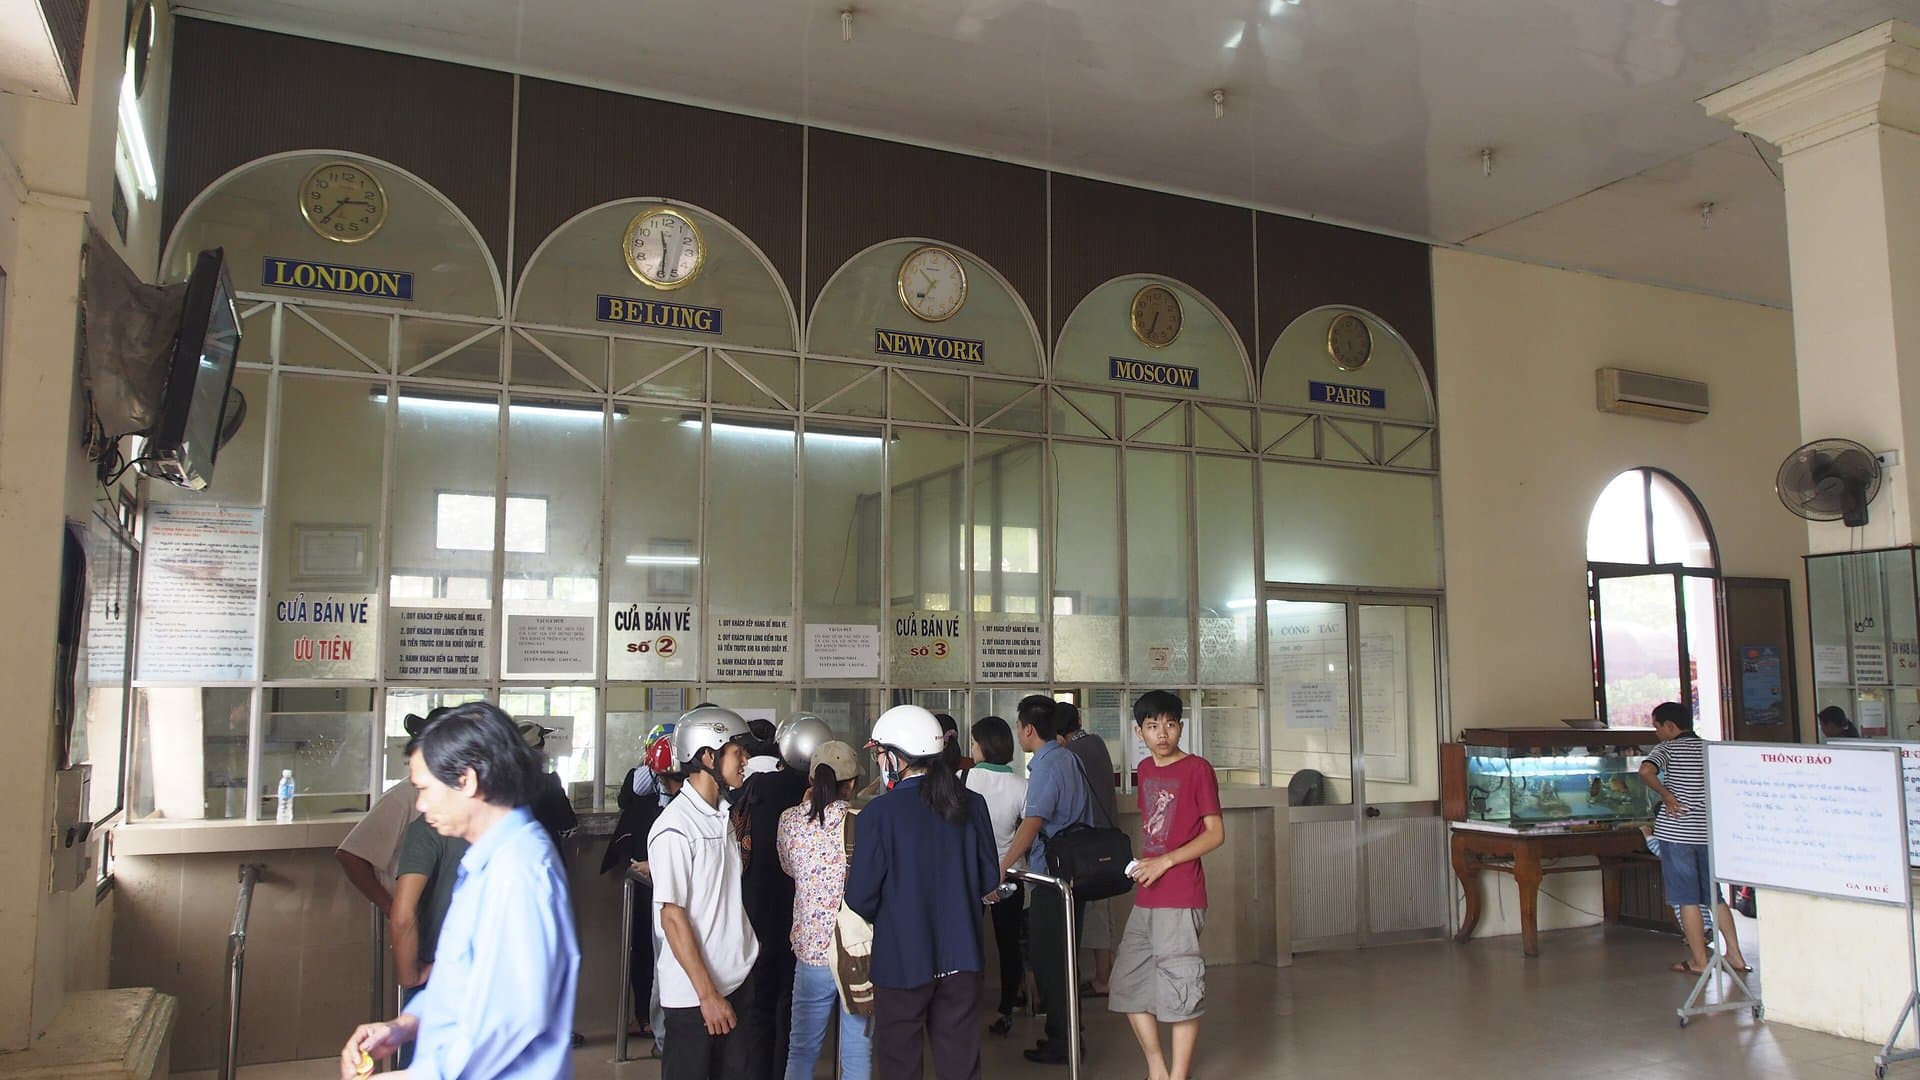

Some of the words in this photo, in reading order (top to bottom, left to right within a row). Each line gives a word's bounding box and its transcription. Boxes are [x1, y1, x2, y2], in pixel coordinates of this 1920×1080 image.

[651, 220, 658, 228] 11
[662, 218, 675, 228] 12
[640, 227, 650, 236] 10
[634, 239, 644, 247] 9
[682, 237, 692, 246] 2
[636, 252, 646, 260] 8
[685, 249, 694, 257] 3
[274, 262, 400, 296] LONDON
[670, 268, 678, 278] 5
[609, 299, 712, 330] BEIJING
[878, 332, 982, 361] NEWYORK
[1116, 361, 1194, 387] MOSCOW
[1325, 385, 1371, 406] PARIS
[277, 593, 307, 621] CỬA
[313, 597, 344, 622] BÁN
[350, 597, 368, 623] VÉ
[615, 604, 640, 631] CỬA
[645, 606, 670, 631] BÁN
[675, 607, 690, 631] VÉ
[896, 612, 917, 636] CỬA
[921, 613, 943, 637] BÁN
[946, 615, 959, 637] VÉ
[1318, 622, 1339, 633] TÁC
[295, 636, 314, 659] ƯU
[319, 635, 351, 660] TIÊN
[627, 640, 651, 653] số
[659, 638, 673, 653] 2
[910, 645, 930, 656] số
[935, 643, 946, 656] 3
[1761, 753, 1802, 764] THÔNG
[1807, 753, 1832, 765] BÁO
